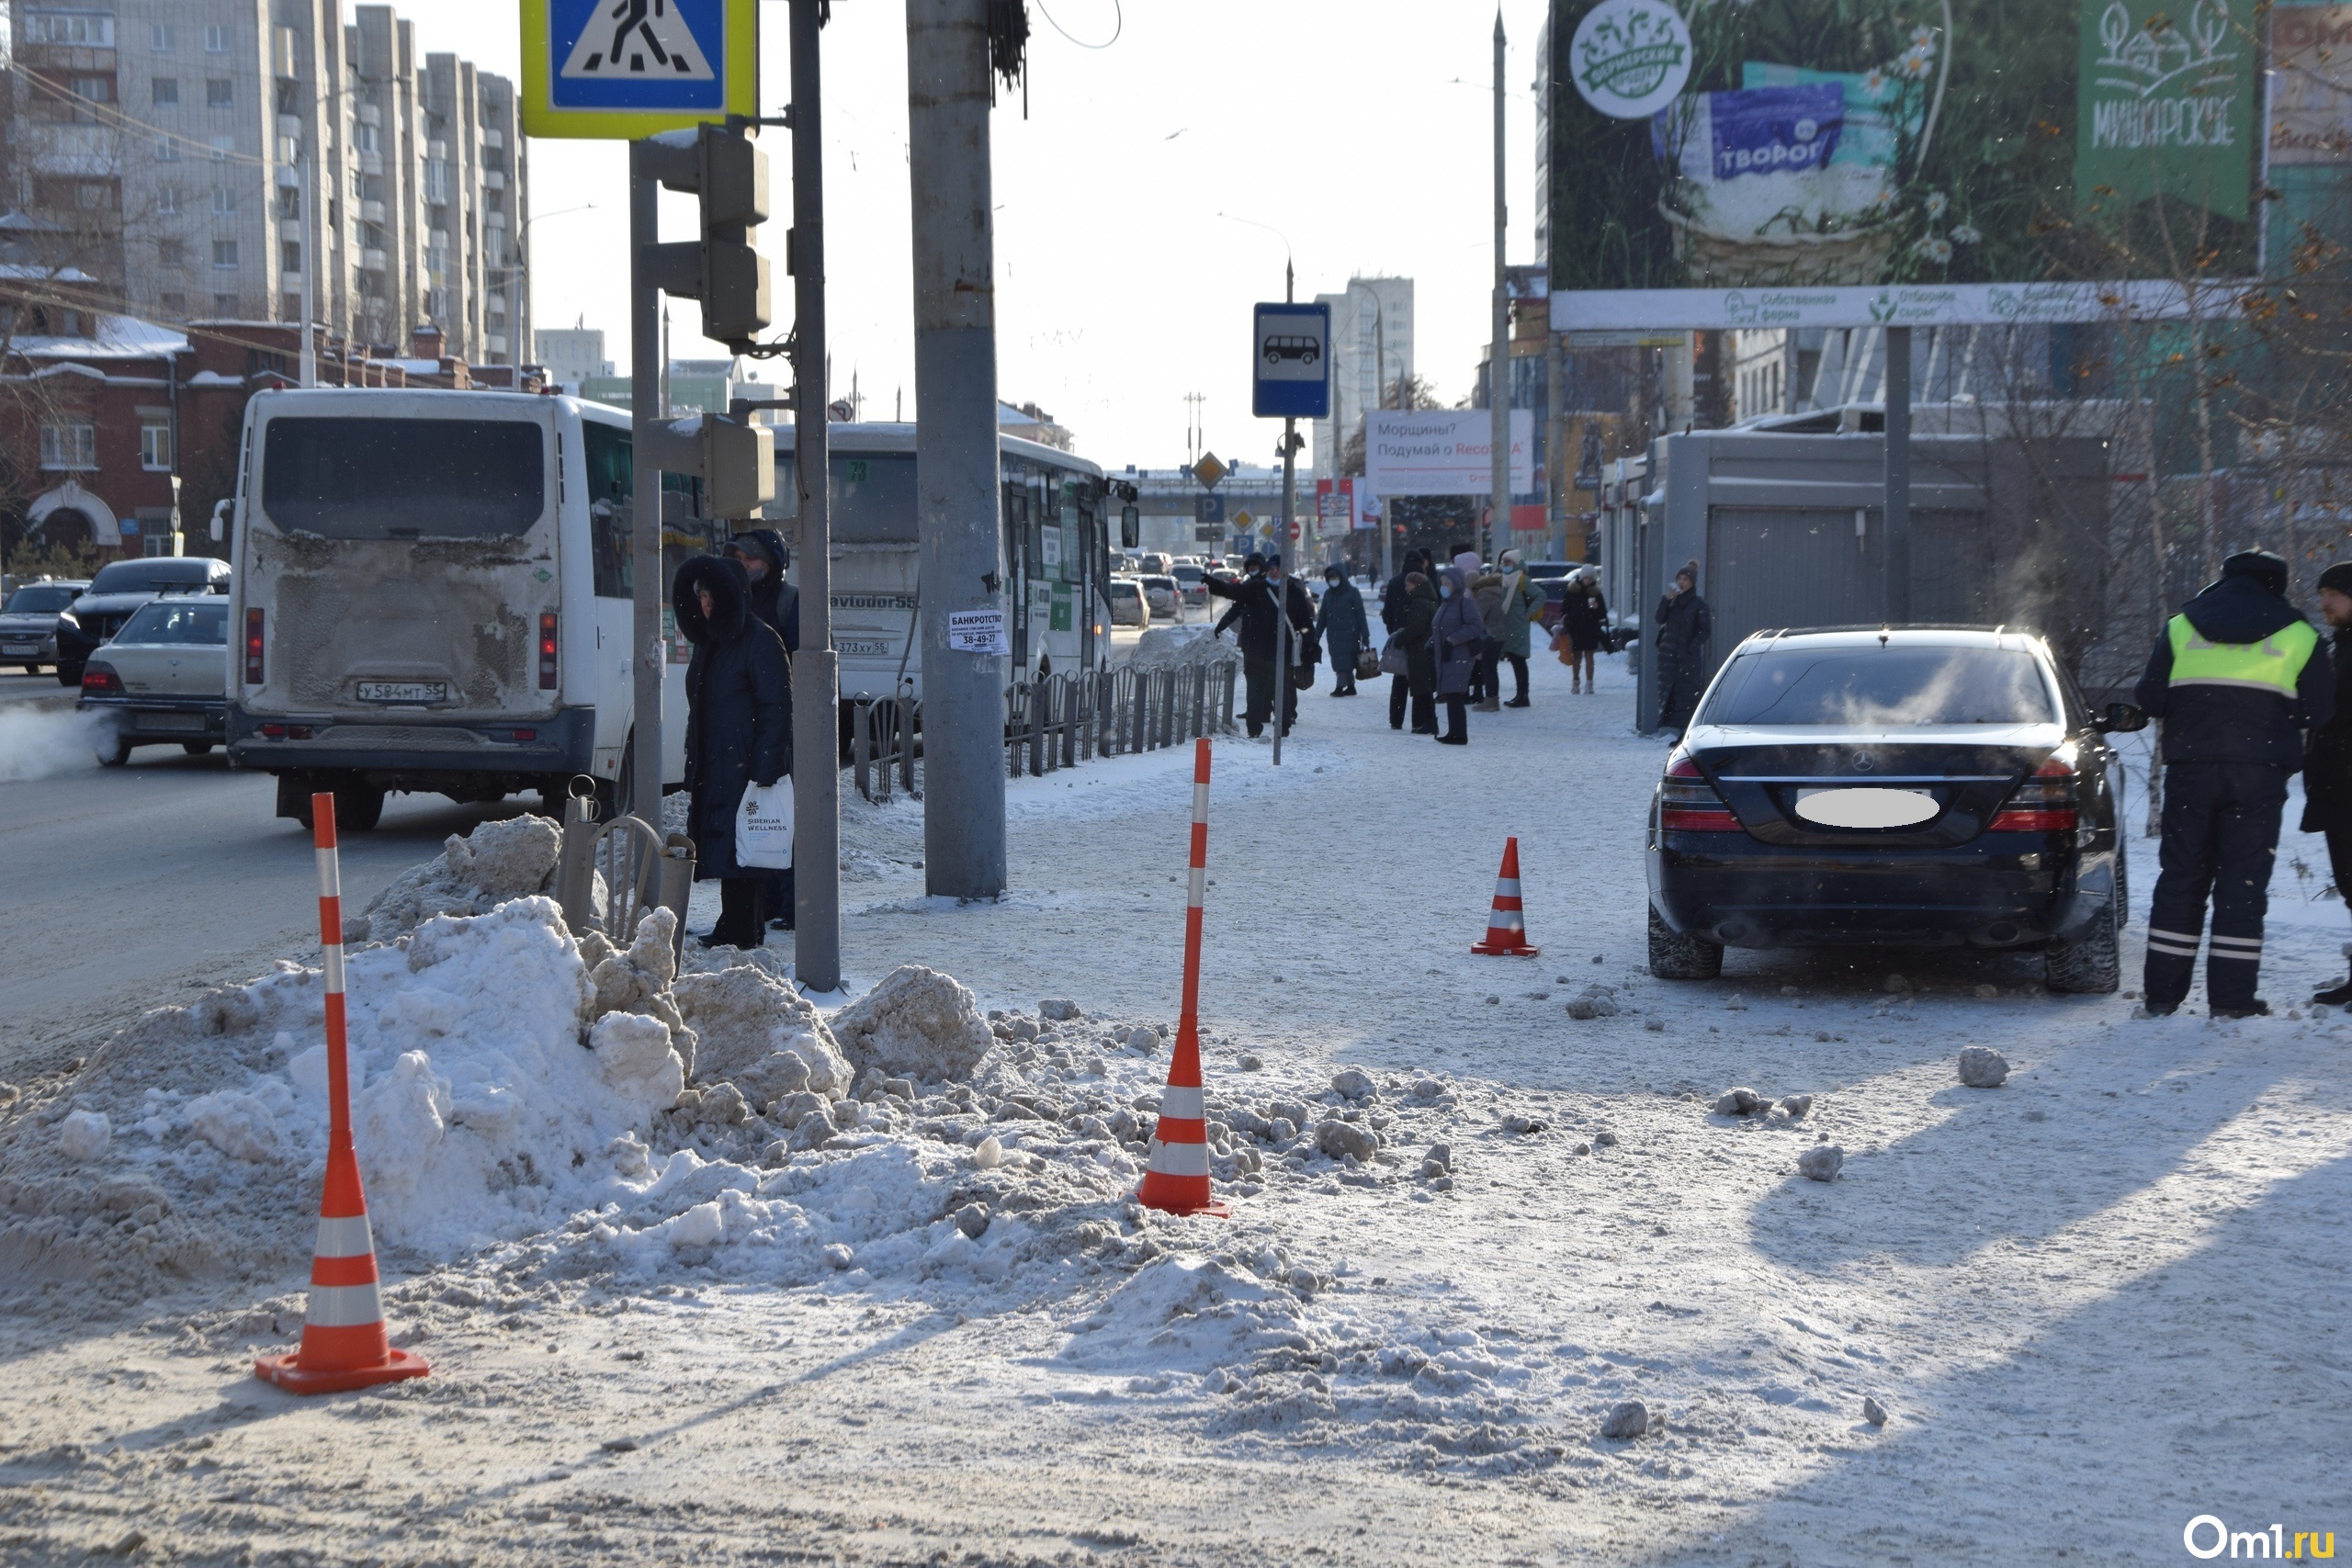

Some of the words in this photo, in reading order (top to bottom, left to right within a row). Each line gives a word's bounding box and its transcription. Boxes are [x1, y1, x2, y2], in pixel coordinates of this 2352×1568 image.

[1720, 141, 1821, 170] ТВОРОГ
[1760, 292, 1837, 306] Собственная
[1760, 309, 1801, 322] ферма
[1378, 423, 1456, 438] Морщины?
[1378, 443, 1440, 458] Подумай
[1444, 446, 1453, 456] о
[850, 461, 866, 482] 73
[952, 615, 1002, 626] БАНКРОТСТВО
[964, 634, 995, 644] 38-49-27
